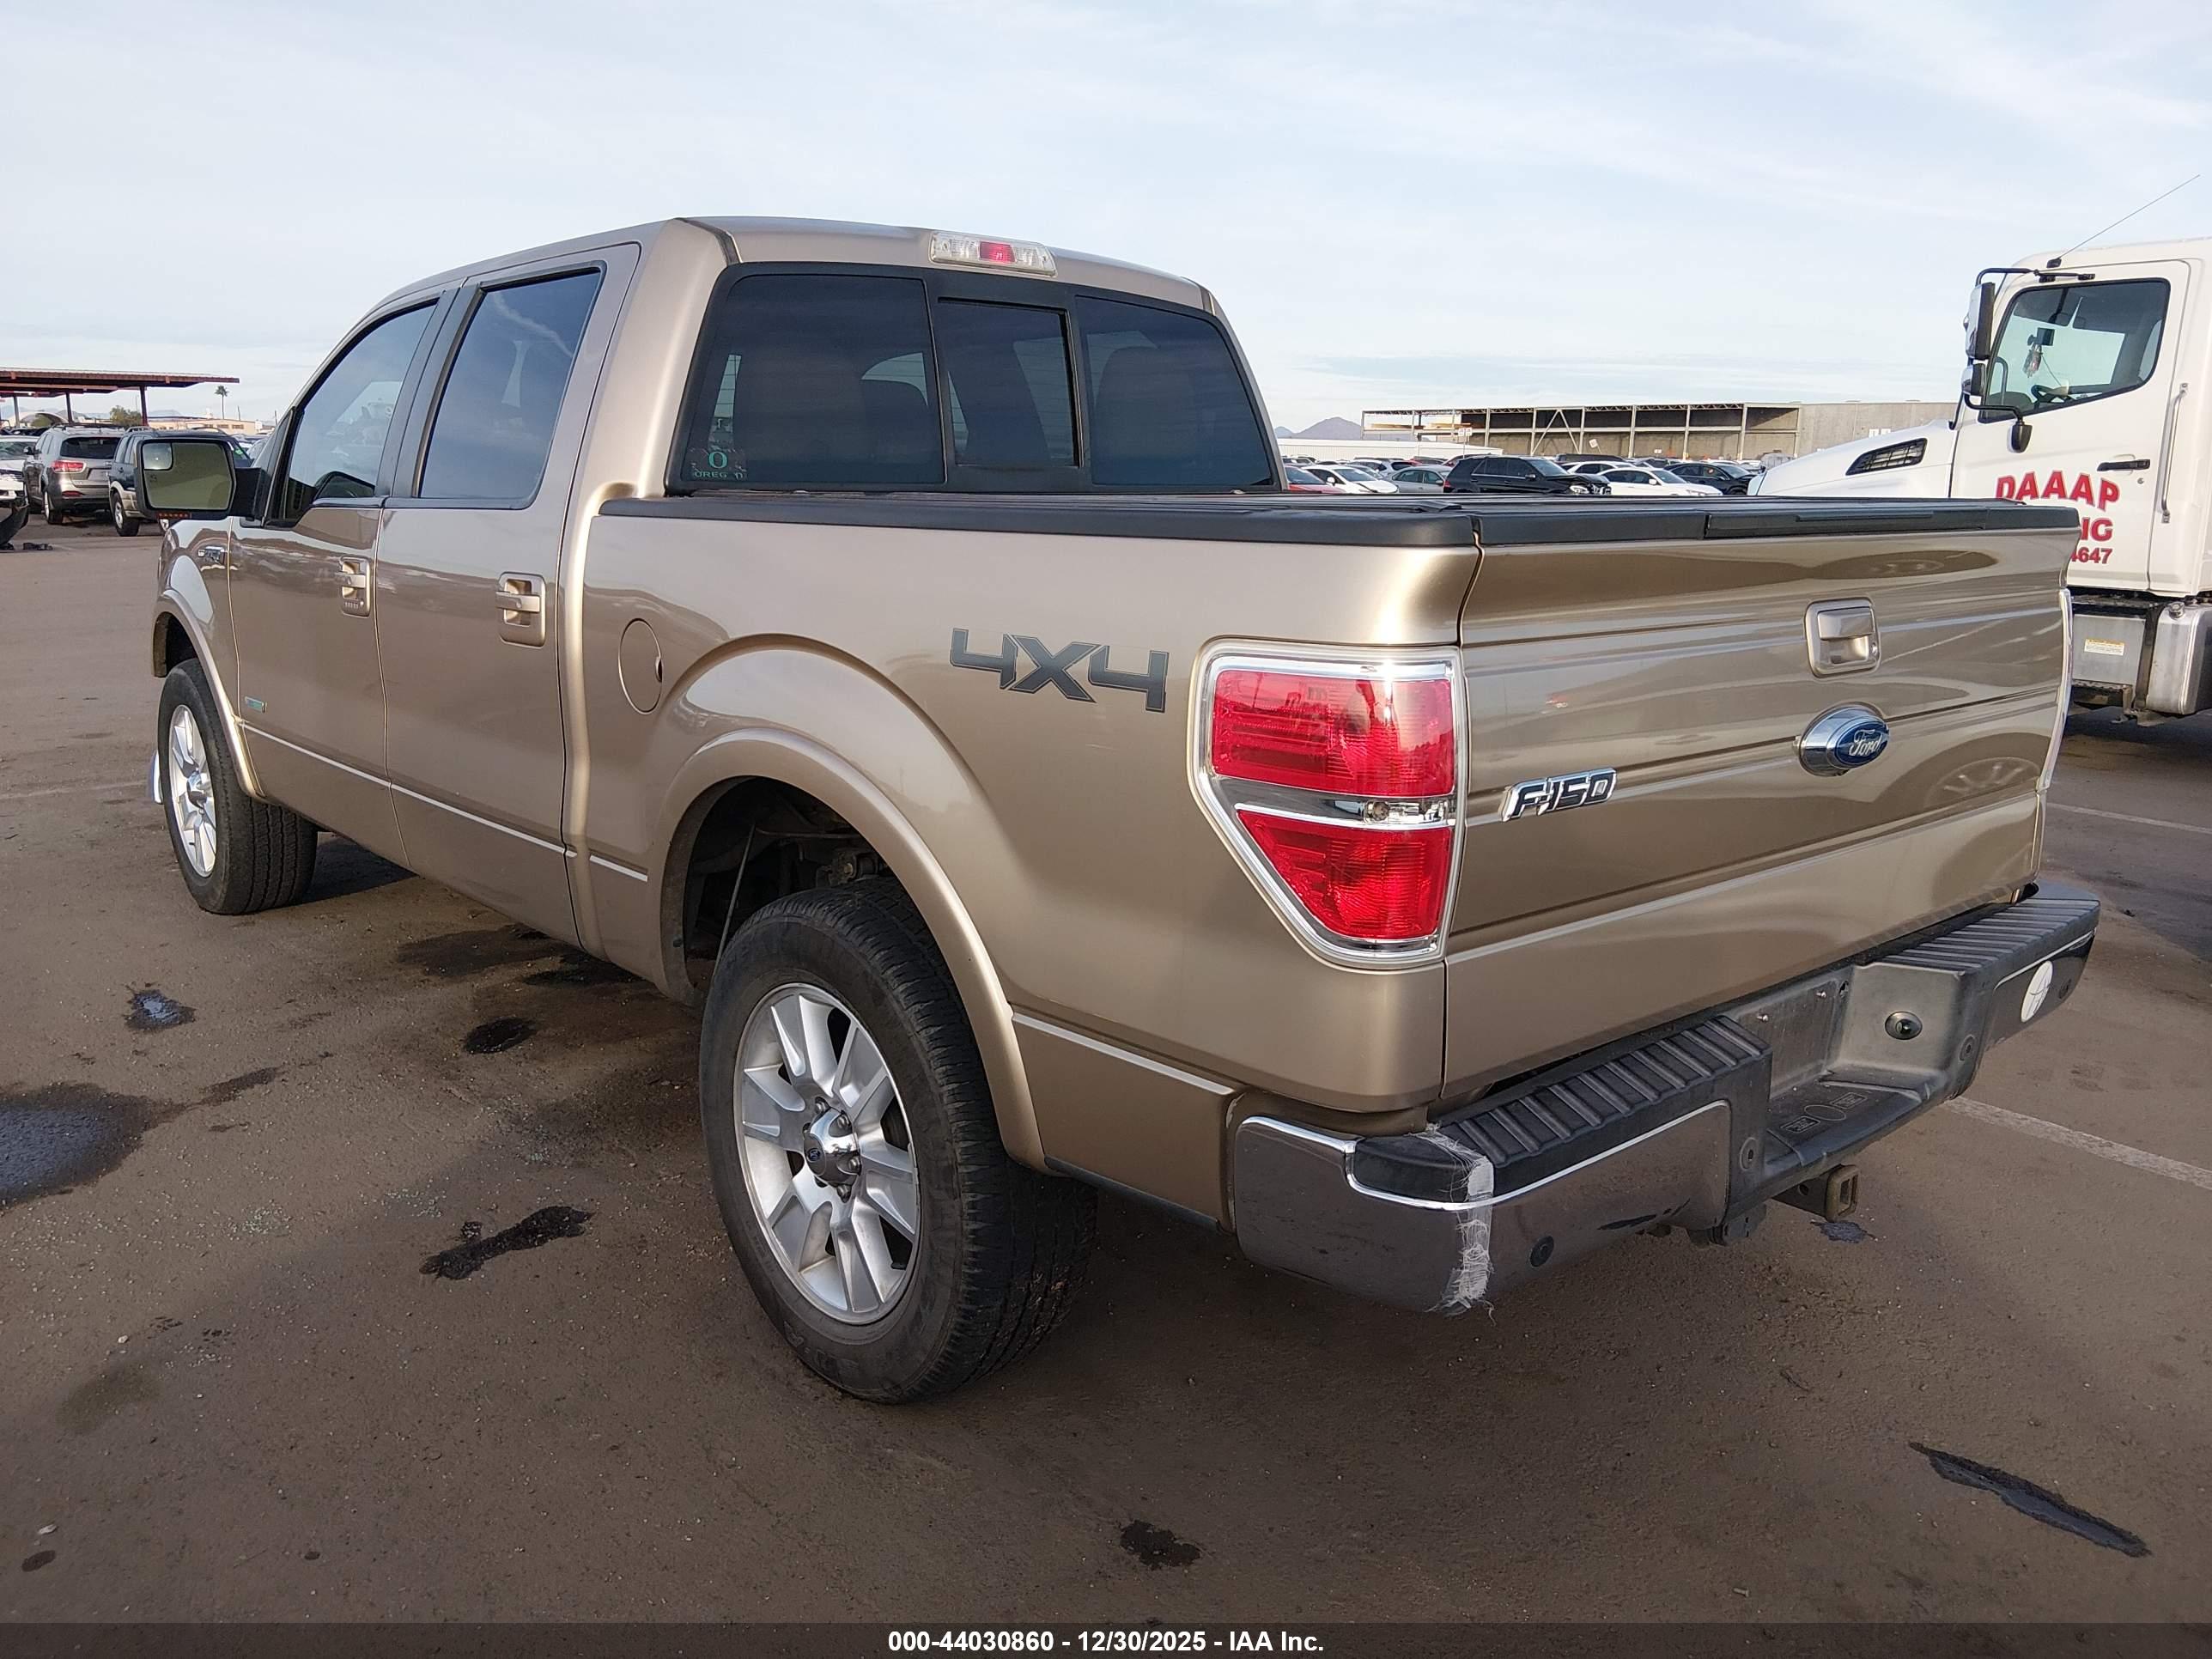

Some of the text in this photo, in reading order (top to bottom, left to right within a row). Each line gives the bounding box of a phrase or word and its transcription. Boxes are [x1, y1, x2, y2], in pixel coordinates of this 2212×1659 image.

[1995, 470, 2121, 513] DAAAP
[1848, 728, 1884, 757] Ford
[1502, 768, 1617, 822] F-150
